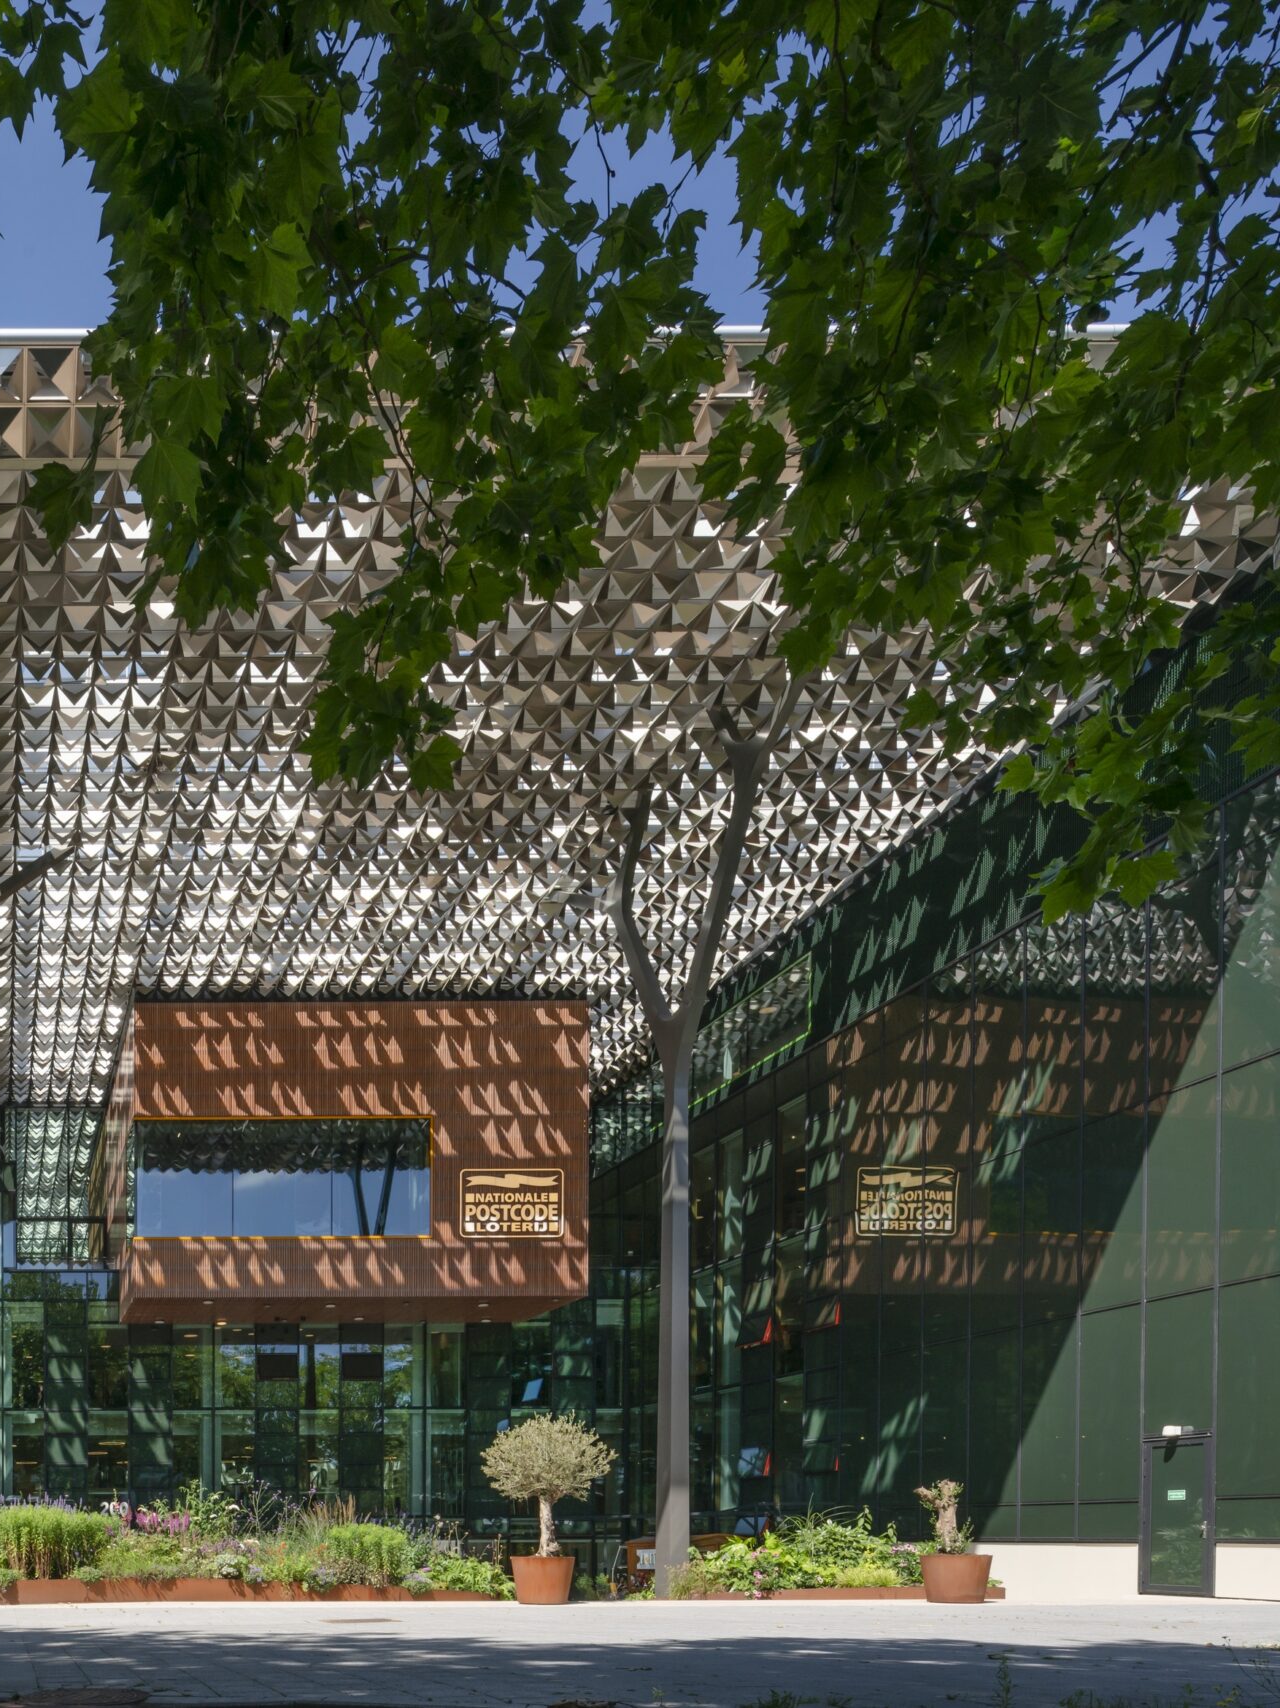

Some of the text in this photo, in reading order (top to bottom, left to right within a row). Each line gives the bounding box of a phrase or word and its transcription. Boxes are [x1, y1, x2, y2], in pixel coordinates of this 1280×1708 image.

[475, 1192, 548, 1202] NATIONALE
[465, 1204, 558, 1221] POSTCODE
[476, 1222, 547, 1232] LOTERIJ
